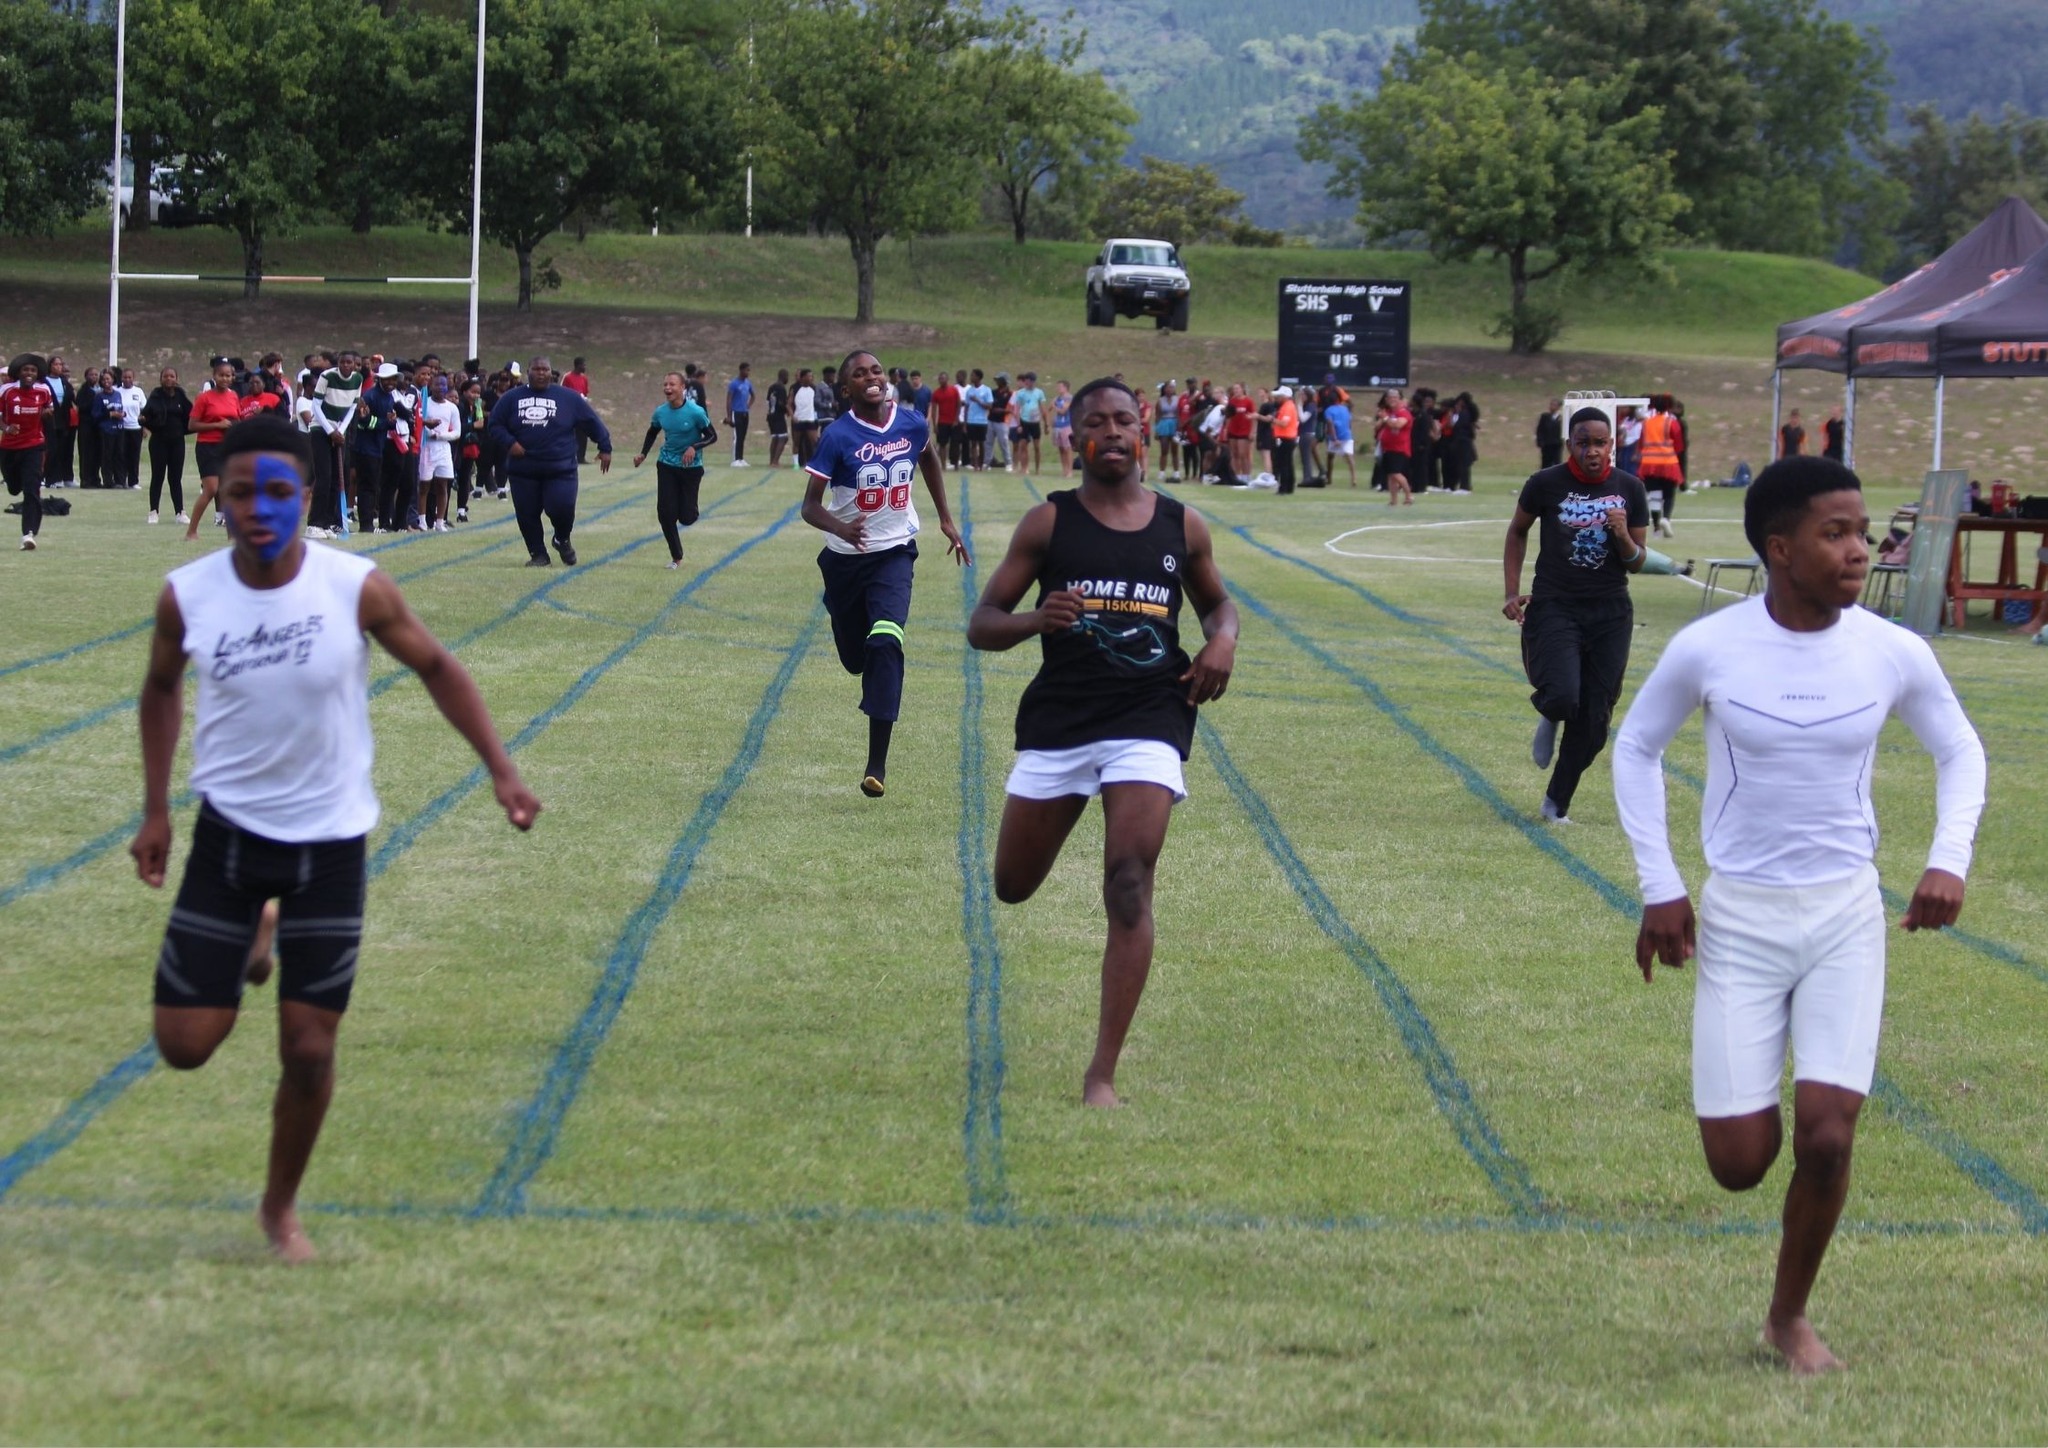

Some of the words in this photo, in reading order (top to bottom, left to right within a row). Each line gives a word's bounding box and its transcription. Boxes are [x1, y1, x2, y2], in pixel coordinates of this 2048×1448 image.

[1285, 284, 1342, 294] Stutterheim
[1344, 286, 1367, 297] High
[1368, 286, 1404, 296] School
[1296, 294, 1329, 312] SHS
[1368, 296, 1384, 312] V
[1332, 334, 1356, 348] 2ND
[1329, 354, 1341, 368] U
[1343, 354, 1359, 368] 15
[855, 438, 909, 462] Originals
[1066, 580, 1128, 598] HOME
[1133, 583, 1170, 604] RUN
[1105, 600, 1141, 613] 15KM
